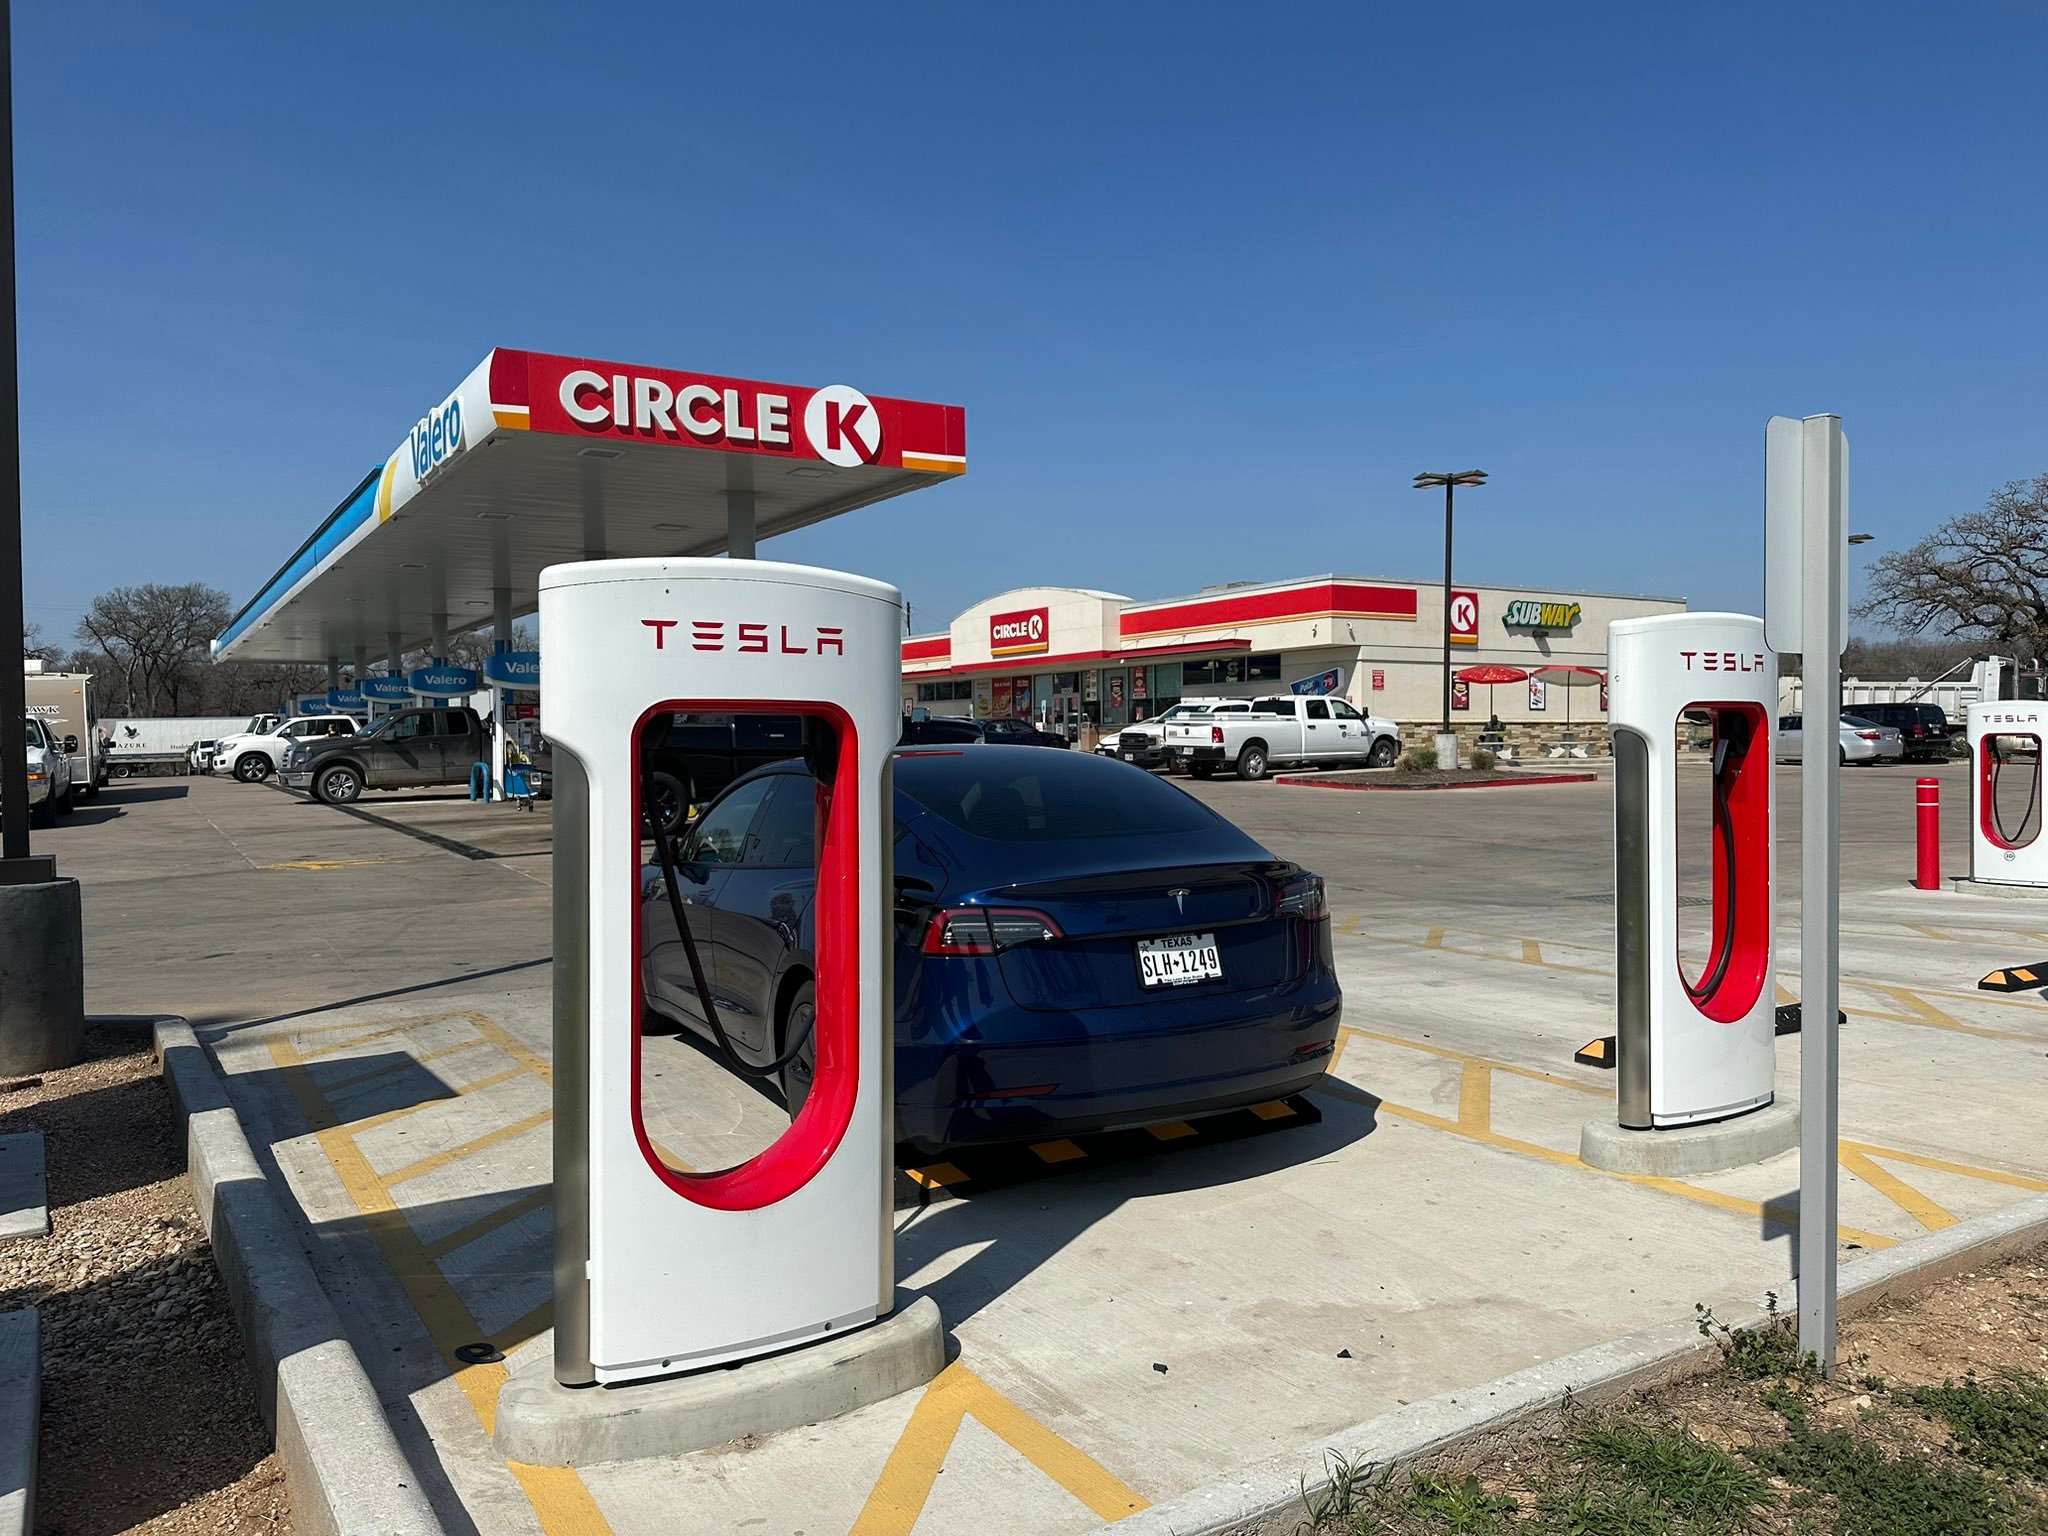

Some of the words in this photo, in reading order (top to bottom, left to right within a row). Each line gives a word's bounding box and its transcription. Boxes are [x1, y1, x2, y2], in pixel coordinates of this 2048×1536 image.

[559, 370, 790, 445] CIRCLE
[411, 399, 460, 480] Valero
[1506, 600, 1581, 627] SUBWAY
[641, 618, 843, 657] TESLA
[992, 621, 1028, 640] CIRCLE
[505, 661, 540, 674] Vale
[1679, 651, 1765, 673] TESLA
[424, 674, 467, 686] Valero
[337, 694, 362, 703] Valer
[309, 703, 327, 711] Vale
[1982, 714, 2038, 723] TESLA
[1161, 937, 1193, 948] TEXAS
